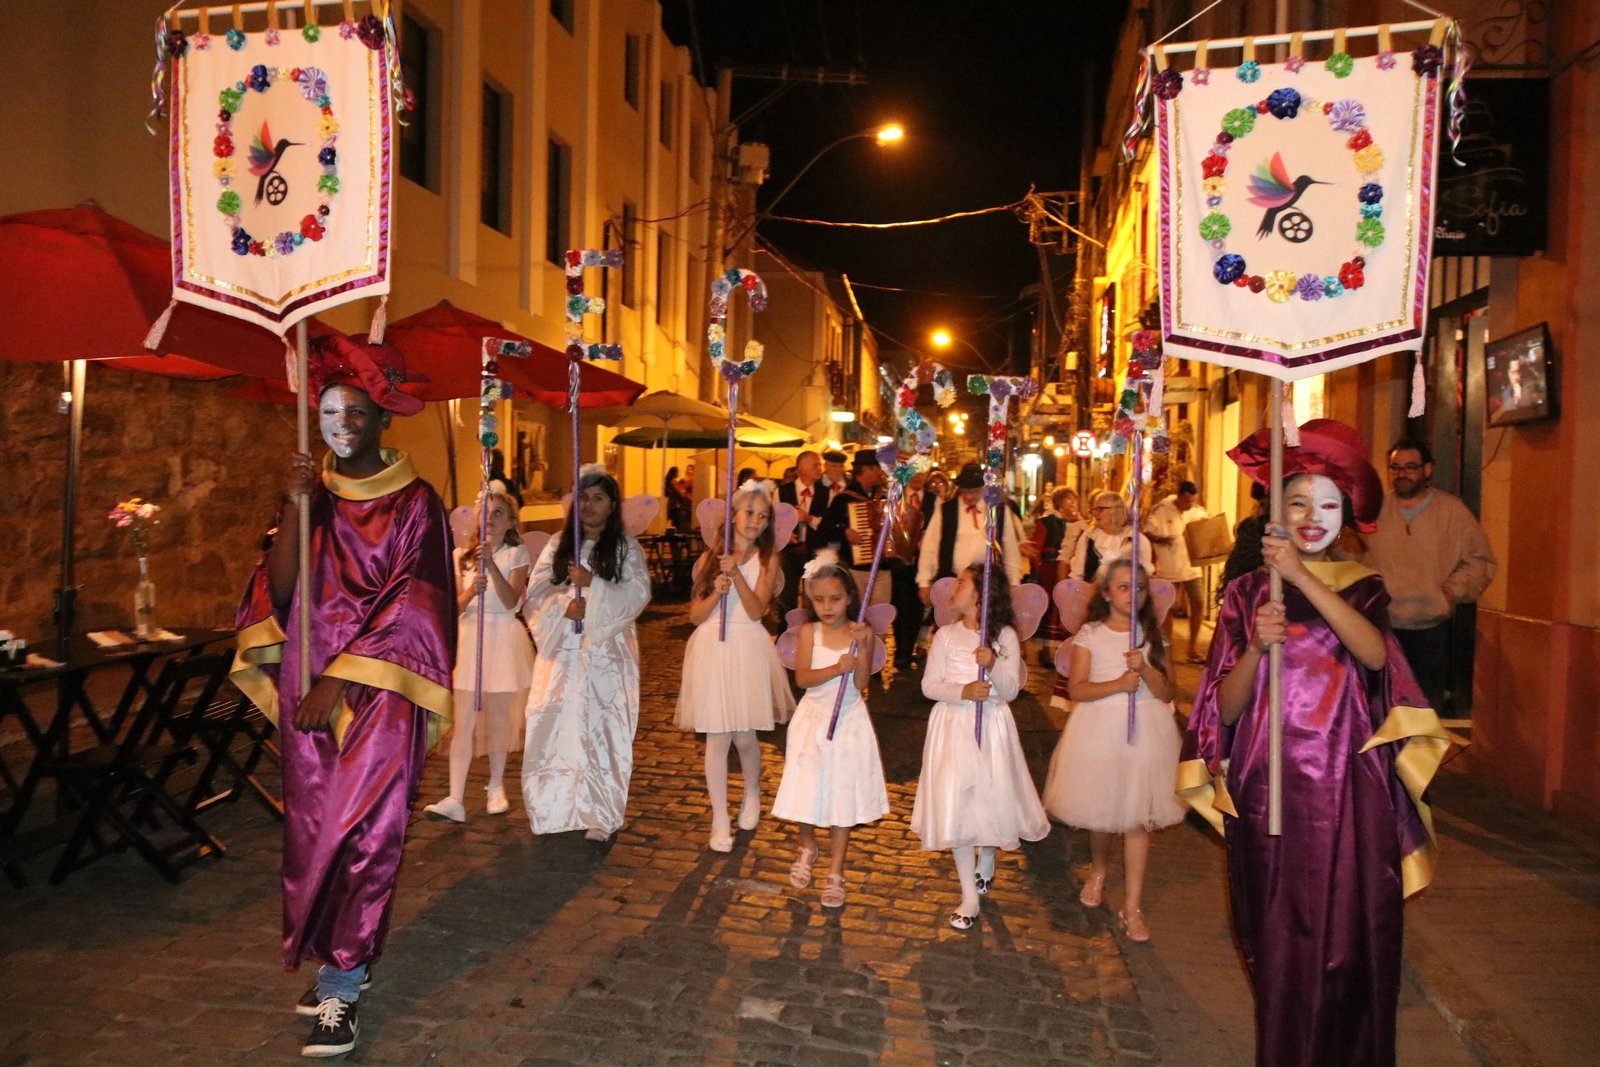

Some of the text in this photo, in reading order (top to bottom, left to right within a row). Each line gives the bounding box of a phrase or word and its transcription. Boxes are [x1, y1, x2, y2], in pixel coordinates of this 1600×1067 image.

[565, 249, 624, 362] E
[479, 336, 532, 449] F
[876, 360, 957, 485] S
[967, 374, 1039, 508] T
